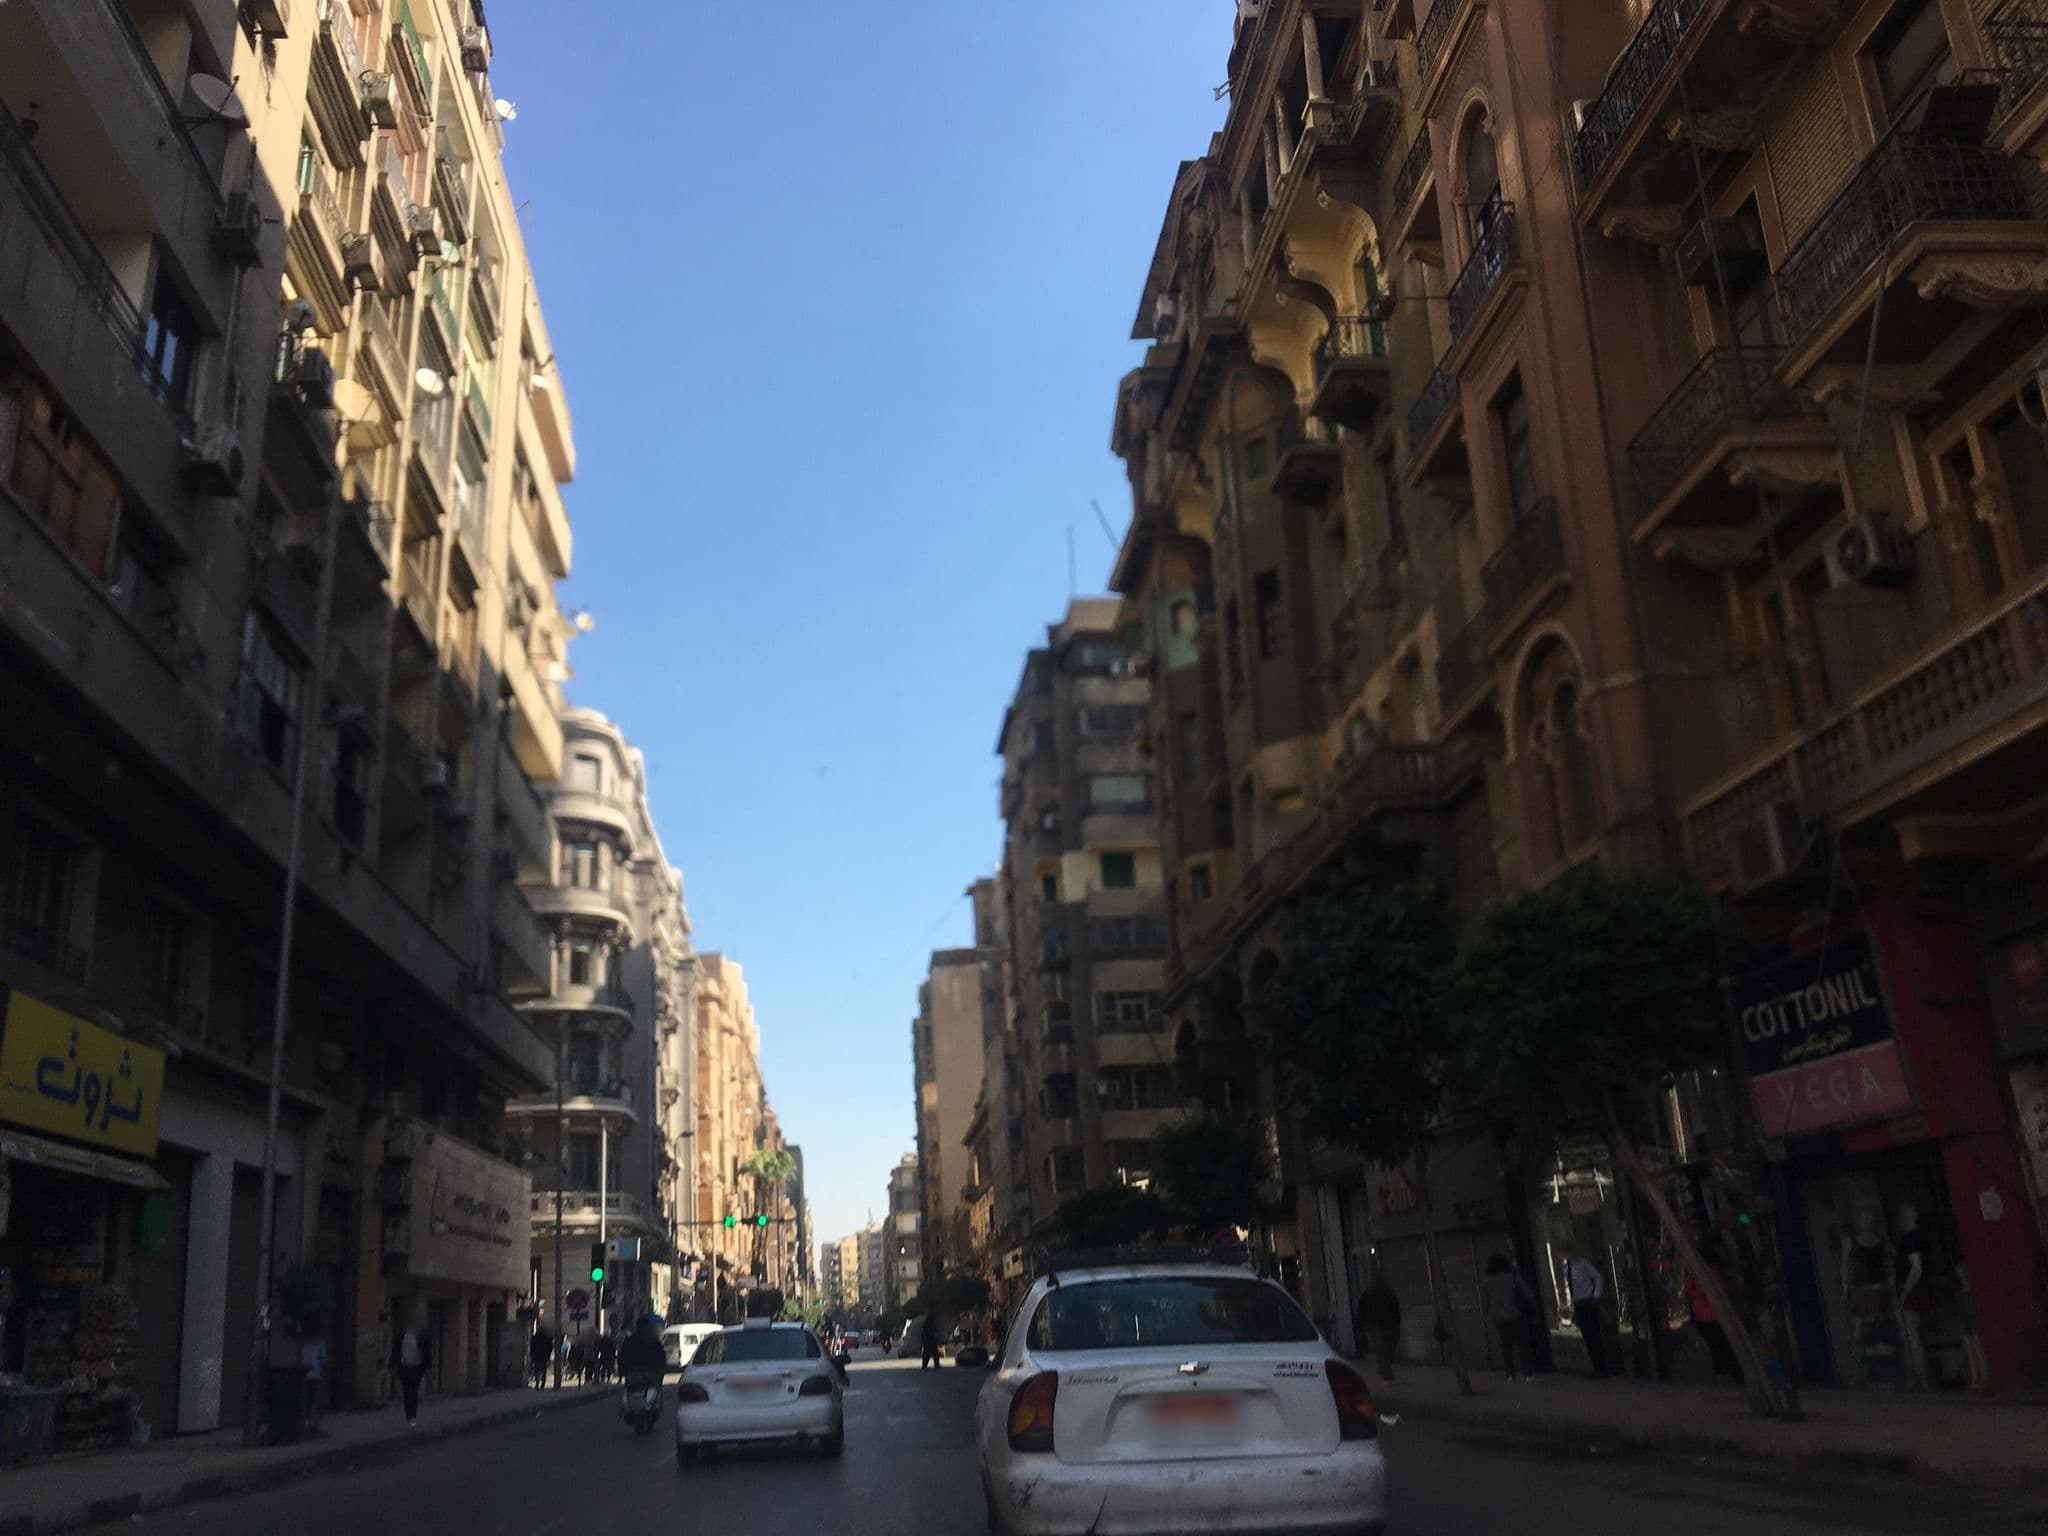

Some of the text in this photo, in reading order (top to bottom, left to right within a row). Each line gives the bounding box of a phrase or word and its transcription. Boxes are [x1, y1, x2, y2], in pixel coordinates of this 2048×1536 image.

[1741, 967, 1878, 1042] COTTONIL
[37, 1028, 143, 1132] ثروت
[1778, 1064, 1882, 1111] VEGA
